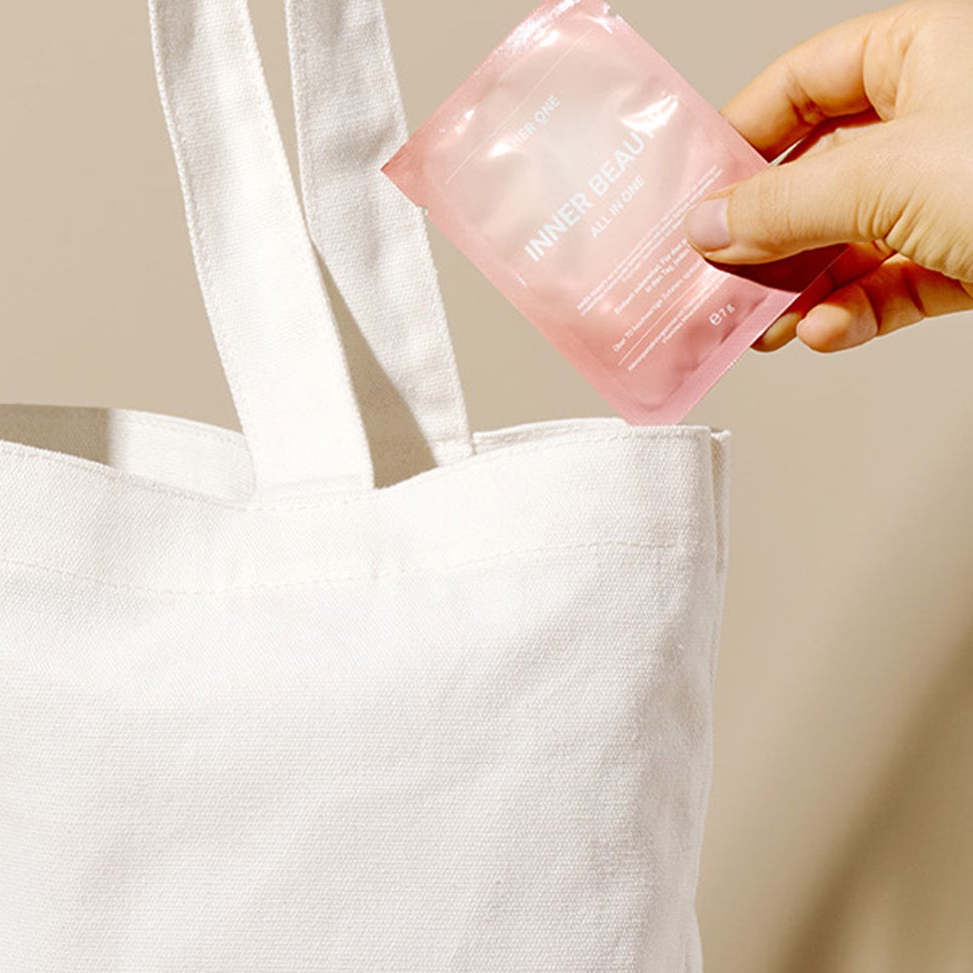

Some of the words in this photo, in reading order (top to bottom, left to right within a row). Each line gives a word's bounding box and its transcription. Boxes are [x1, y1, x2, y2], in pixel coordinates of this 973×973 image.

[524, 192, 594, 262] INNER
[590, 214, 613, 238] ALL
[609, 202, 624, 217] IN
[620, 175, 646, 203] ONE
